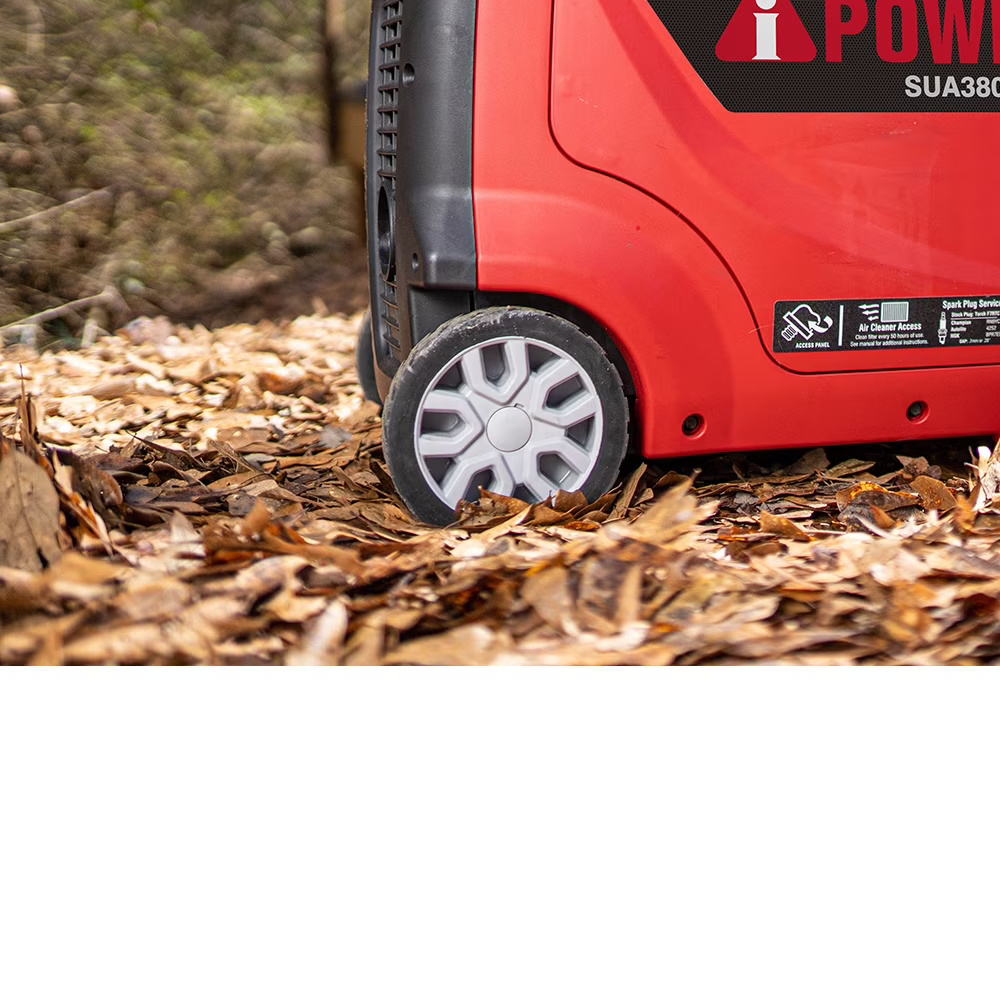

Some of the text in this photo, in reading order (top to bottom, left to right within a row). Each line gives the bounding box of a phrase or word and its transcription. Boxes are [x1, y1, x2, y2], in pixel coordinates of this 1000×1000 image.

[942, 300, 962, 310] Spark
[963, 300, 978, 309] Plug
[858, 322, 922, 332] Air Cleaner Access
